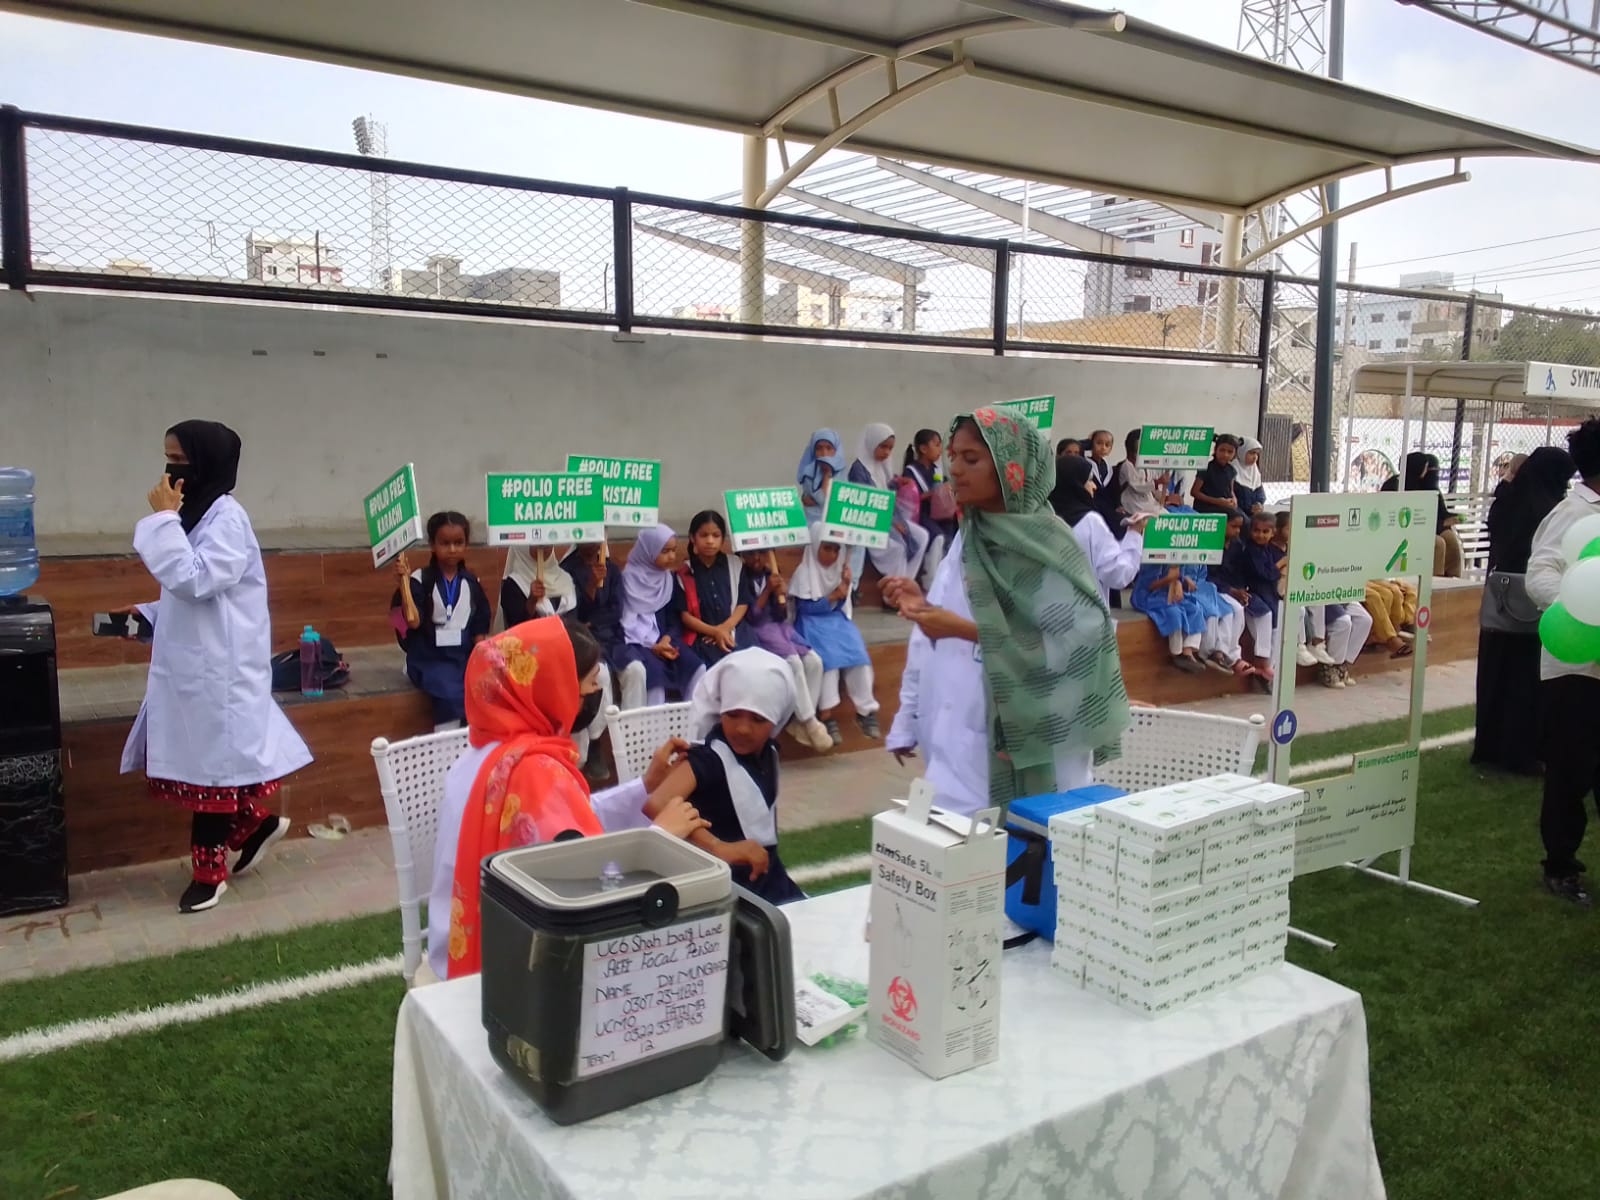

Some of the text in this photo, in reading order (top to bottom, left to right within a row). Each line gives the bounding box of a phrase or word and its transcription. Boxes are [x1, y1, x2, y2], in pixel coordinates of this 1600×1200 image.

[1570, 368, 1600, 389] SYNTH
[1030, 399, 1050, 414] FREE
[1149, 427, 1207, 441] #POLIO FREE
[1163, 442, 1189, 455] SINDH
[578, 458, 653, 481] #POLIO FREE
[369, 473, 407, 518] #POLIO FREE
[501, 476, 593, 498] #POLIO FREE
[602, 484, 642, 505] KISTAN
[735, 490, 794, 510] #POLIO FREE
[837, 486, 890, 510] #POLIO FREE
[377, 501, 403, 539] KARACHI
[514, 500, 577, 521] KARACHI
[746, 510, 788, 528] KARACHI
[840, 507, 878, 528] KARACHI
[1154, 518, 1218, 532] #POLIO FREE
[1170, 534, 1198, 547] SINDH
[1350, 564, 1362, 573] Dose
[1289, 586, 1365, 604] #MazbootQadam
[920, 859, 932, 876] 5L
[878, 863, 912, 893] Safety
[915, 880, 937, 902] Box
